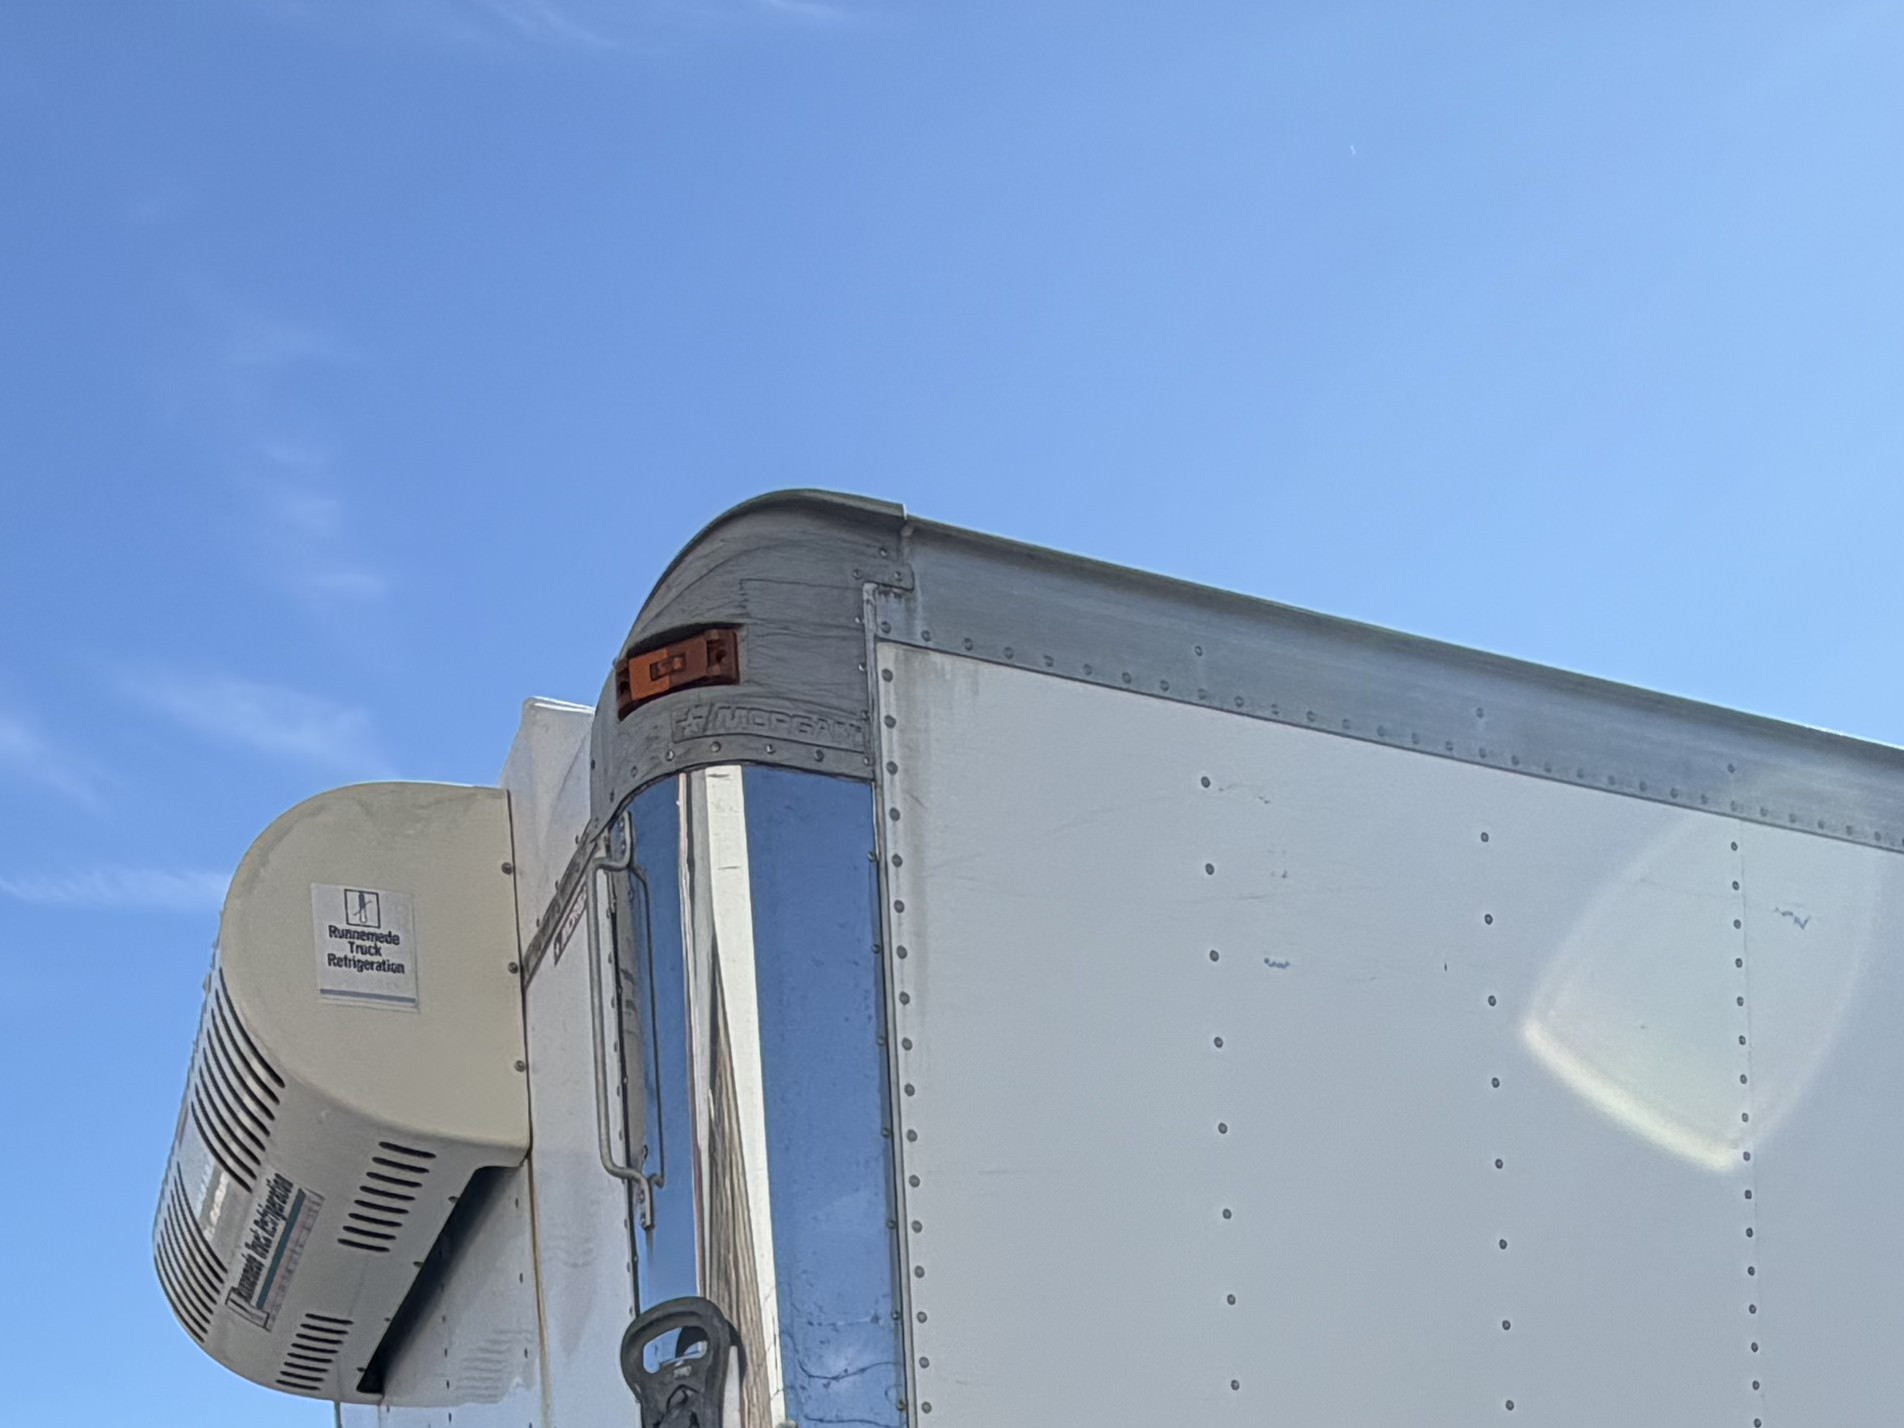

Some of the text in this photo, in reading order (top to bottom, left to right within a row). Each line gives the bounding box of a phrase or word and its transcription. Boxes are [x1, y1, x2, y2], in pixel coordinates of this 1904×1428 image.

[328, 925, 400, 946] Runnemede
[348, 941, 382, 957] Truck
[327, 953, 405, 974] Refrigeration
